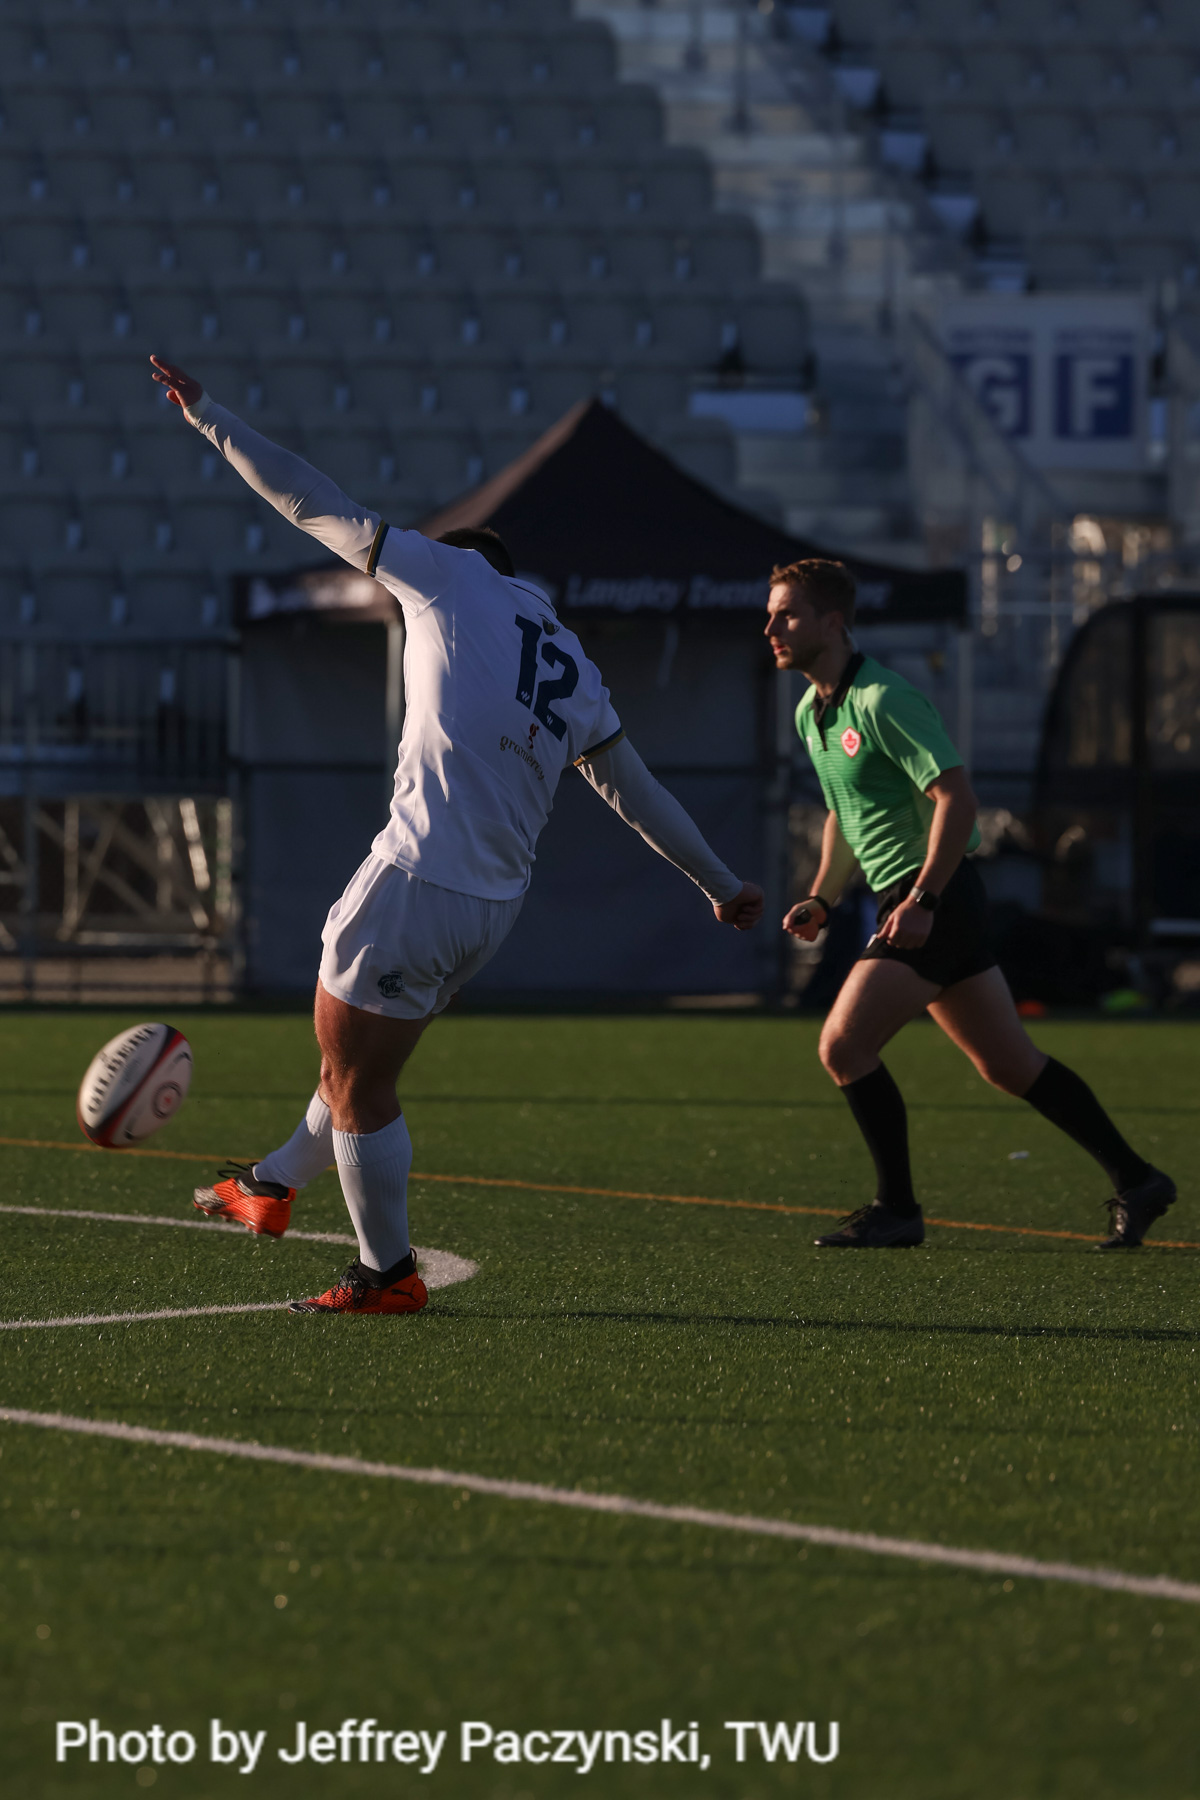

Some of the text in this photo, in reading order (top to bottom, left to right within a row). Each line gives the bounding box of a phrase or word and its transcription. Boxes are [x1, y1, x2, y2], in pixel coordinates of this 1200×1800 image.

[965, 356, 1021, 434] G
[1073, 356, 1120, 436] F
[689, 573, 771, 610] Event
[514, 613, 580, 743] 12
[499, 734, 546, 782] gramercy
